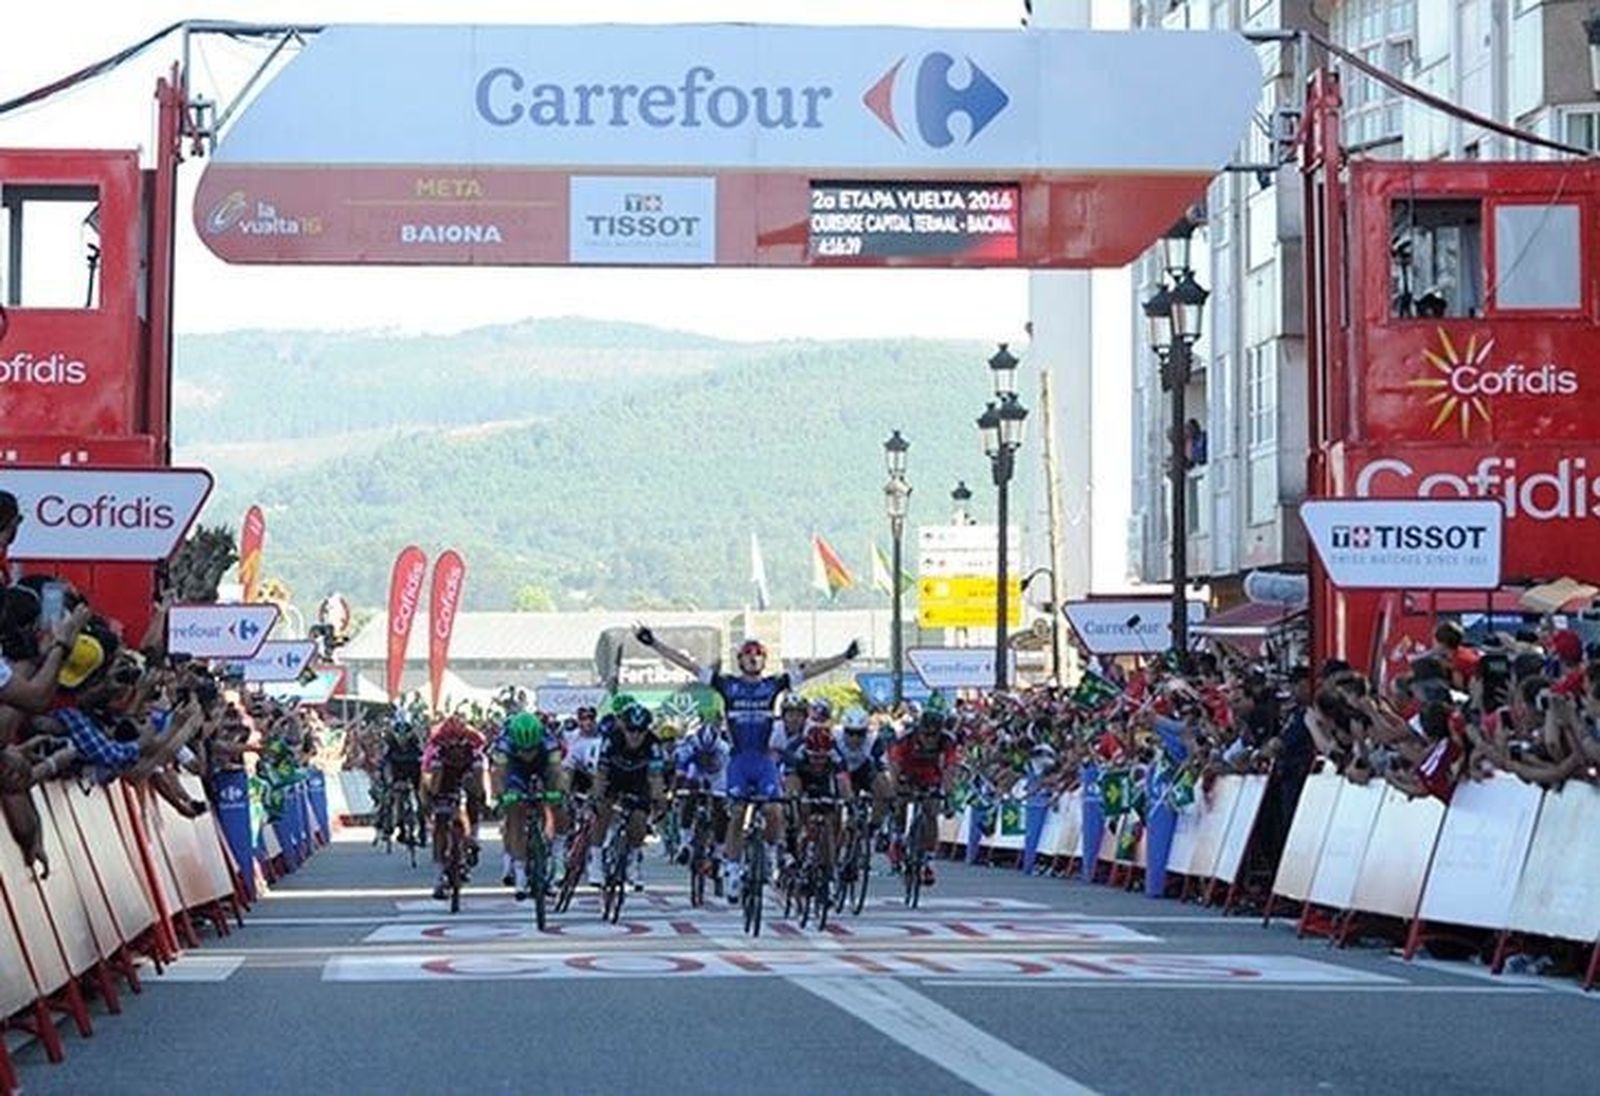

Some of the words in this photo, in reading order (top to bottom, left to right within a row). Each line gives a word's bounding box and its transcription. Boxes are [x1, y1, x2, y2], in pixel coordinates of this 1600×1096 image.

[475, 67, 833, 129] Carrefour
[416, 178, 482, 197] META
[257, 201, 276, 218] la
[838, 190, 897, 209] ETAPA
[898, 190, 966, 209] VUELTA
[966, 190, 1013, 210] 2016
[401, 224, 502, 243] BAIONA
[586, 215, 701, 237] TISSOT
[865, 214, 912, 233] CAPITAL
[913, 214, 959, 233] TERMAL
[966, 214, 1014, 233] BAIONA
[1451, 364, 1579, 394] Cofidis
[1356, 458, 1600, 518] Cofidi
[36, 494, 175, 529] Cofidis
[1376, 525, 1487, 550] TISSOT
[393, 561, 424, 635] Cofidis
[436, 566, 462, 639] Cofidis
[420, 952, 1263, 976] COFIDIS
